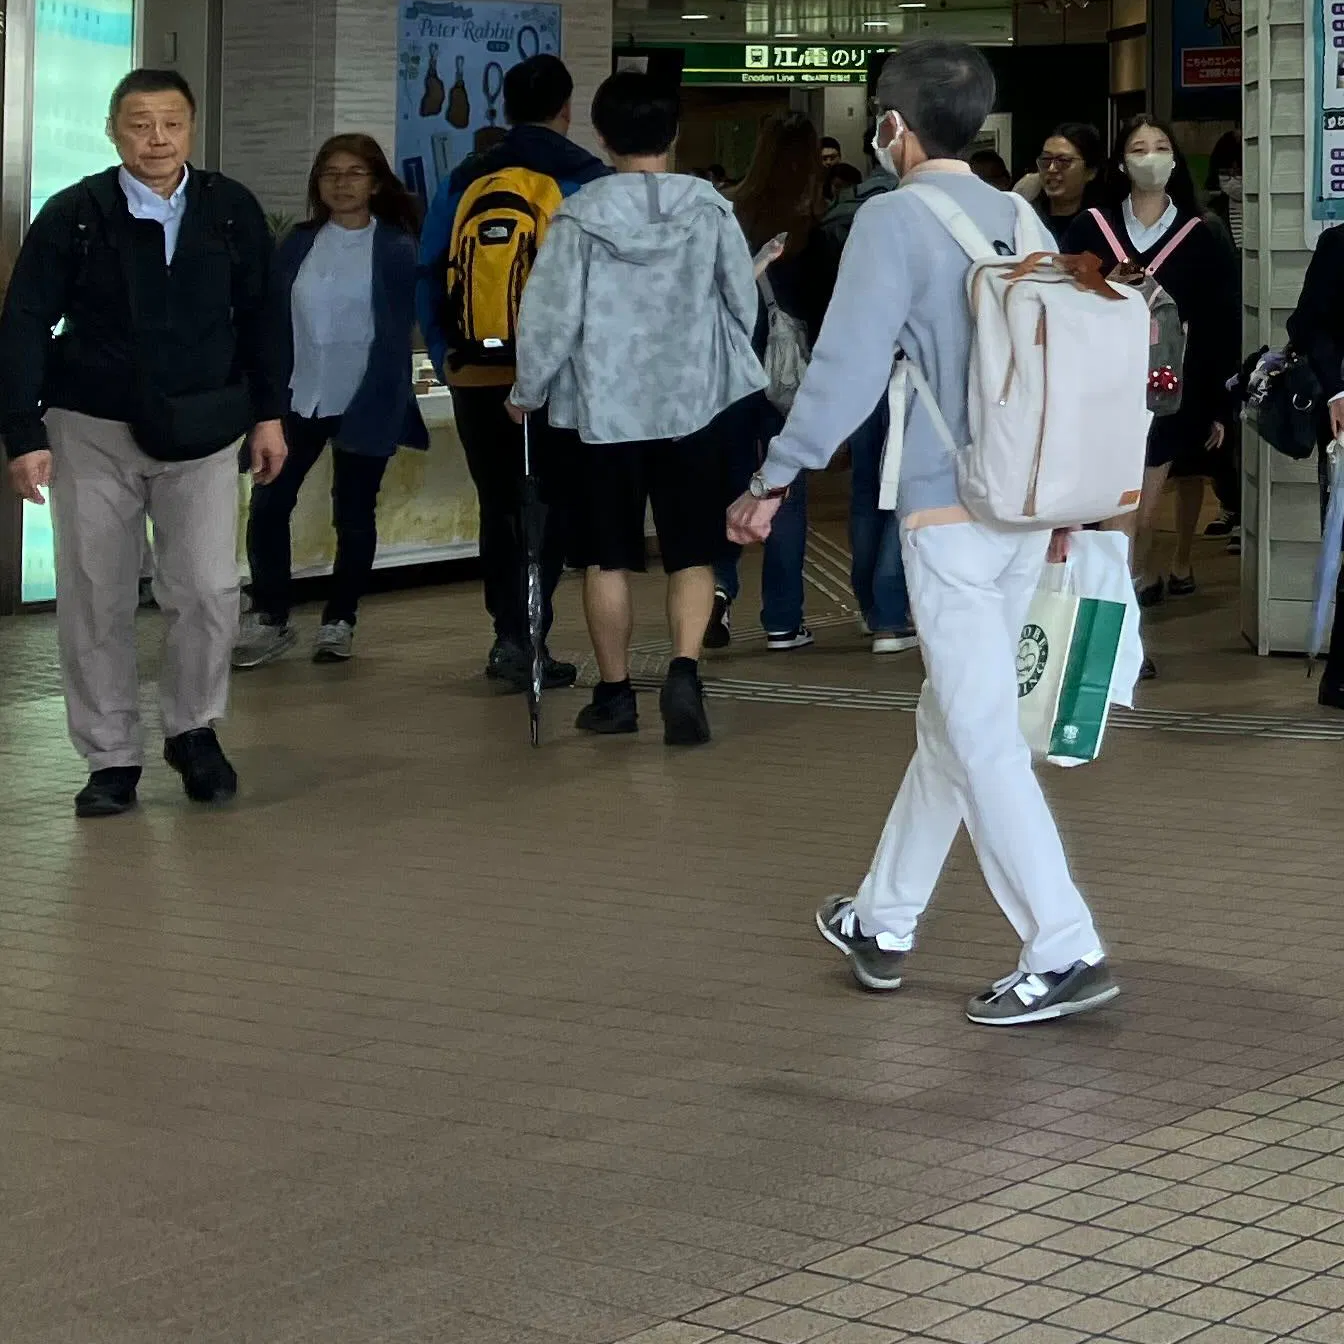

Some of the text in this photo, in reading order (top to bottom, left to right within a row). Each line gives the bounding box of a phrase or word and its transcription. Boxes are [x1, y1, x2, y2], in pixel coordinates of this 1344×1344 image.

[419, 17, 515, 43] Peter Rabbit
[777, 73, 796, 83] Line
